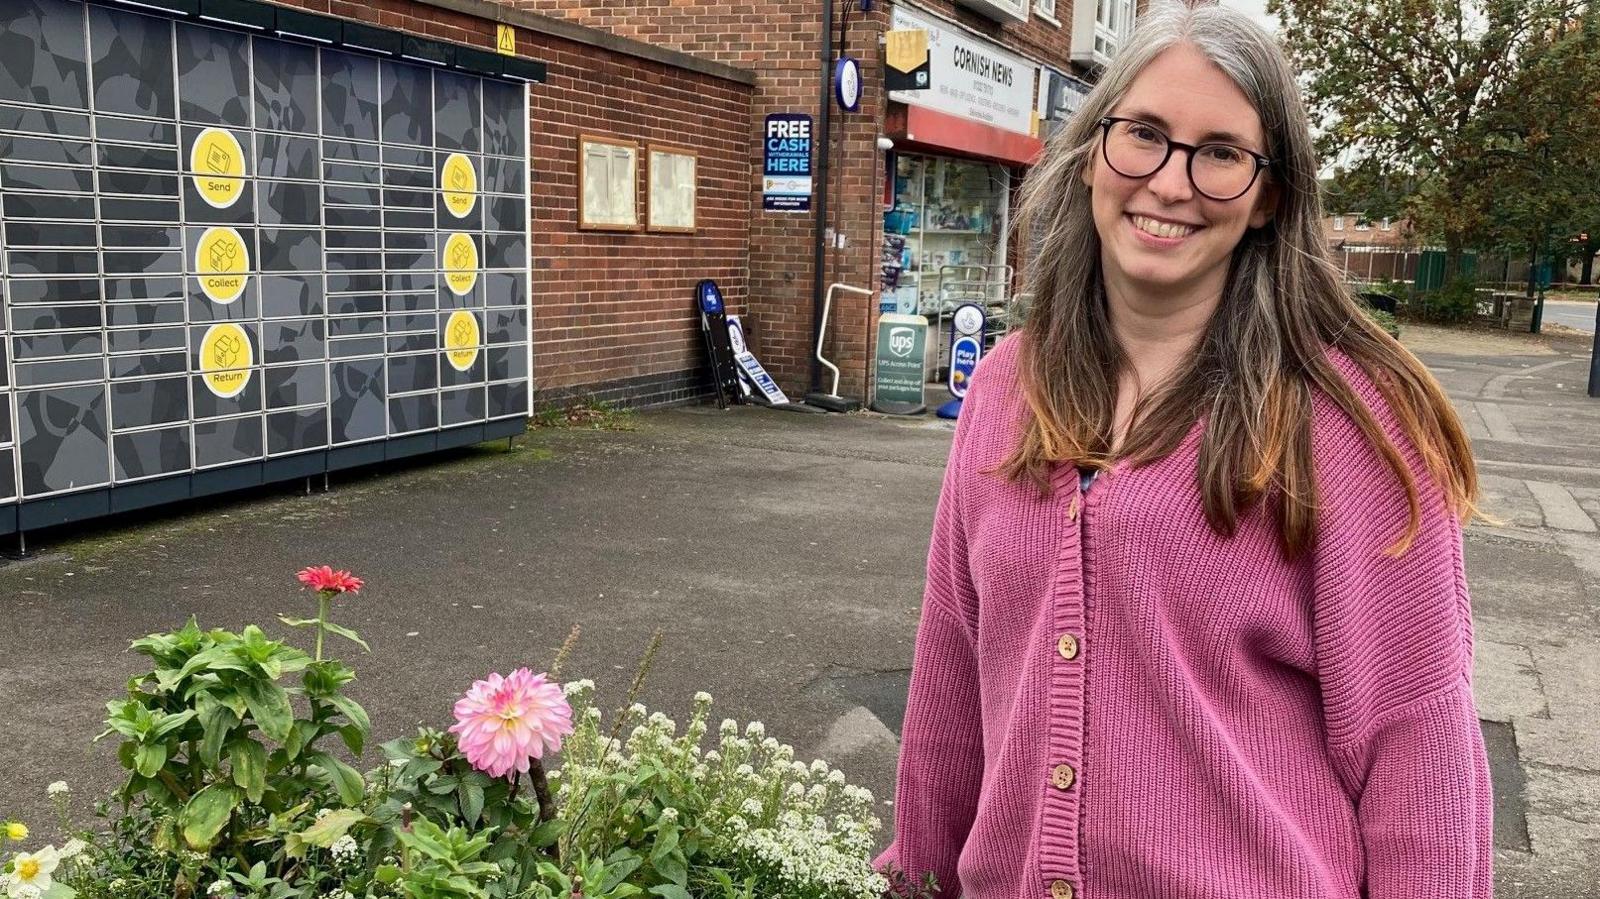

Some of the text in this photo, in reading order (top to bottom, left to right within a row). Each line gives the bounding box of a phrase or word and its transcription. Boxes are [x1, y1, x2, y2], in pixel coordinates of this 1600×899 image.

[954, 45, 1013, 87] CORNISH NEWS
[768, 120, 810, 138] FREE
[768, 139, 809, 152] CASH
[767, 158, 809, 171] HERE
[208, 182, 231, 192] Send
[452, 196, 467, 205] Send
[208, 278, 239, 288] Collect
[451, 274, 471, 283] Collect
[892, 336, 913, 353] ups
[453, 350, 473, 358] Return
[957, 350, 975, 360] Play
[878, 359, 890, 367] UPS
[957, 358, 975, 366] here
[213, 372, 243, 382] Return
